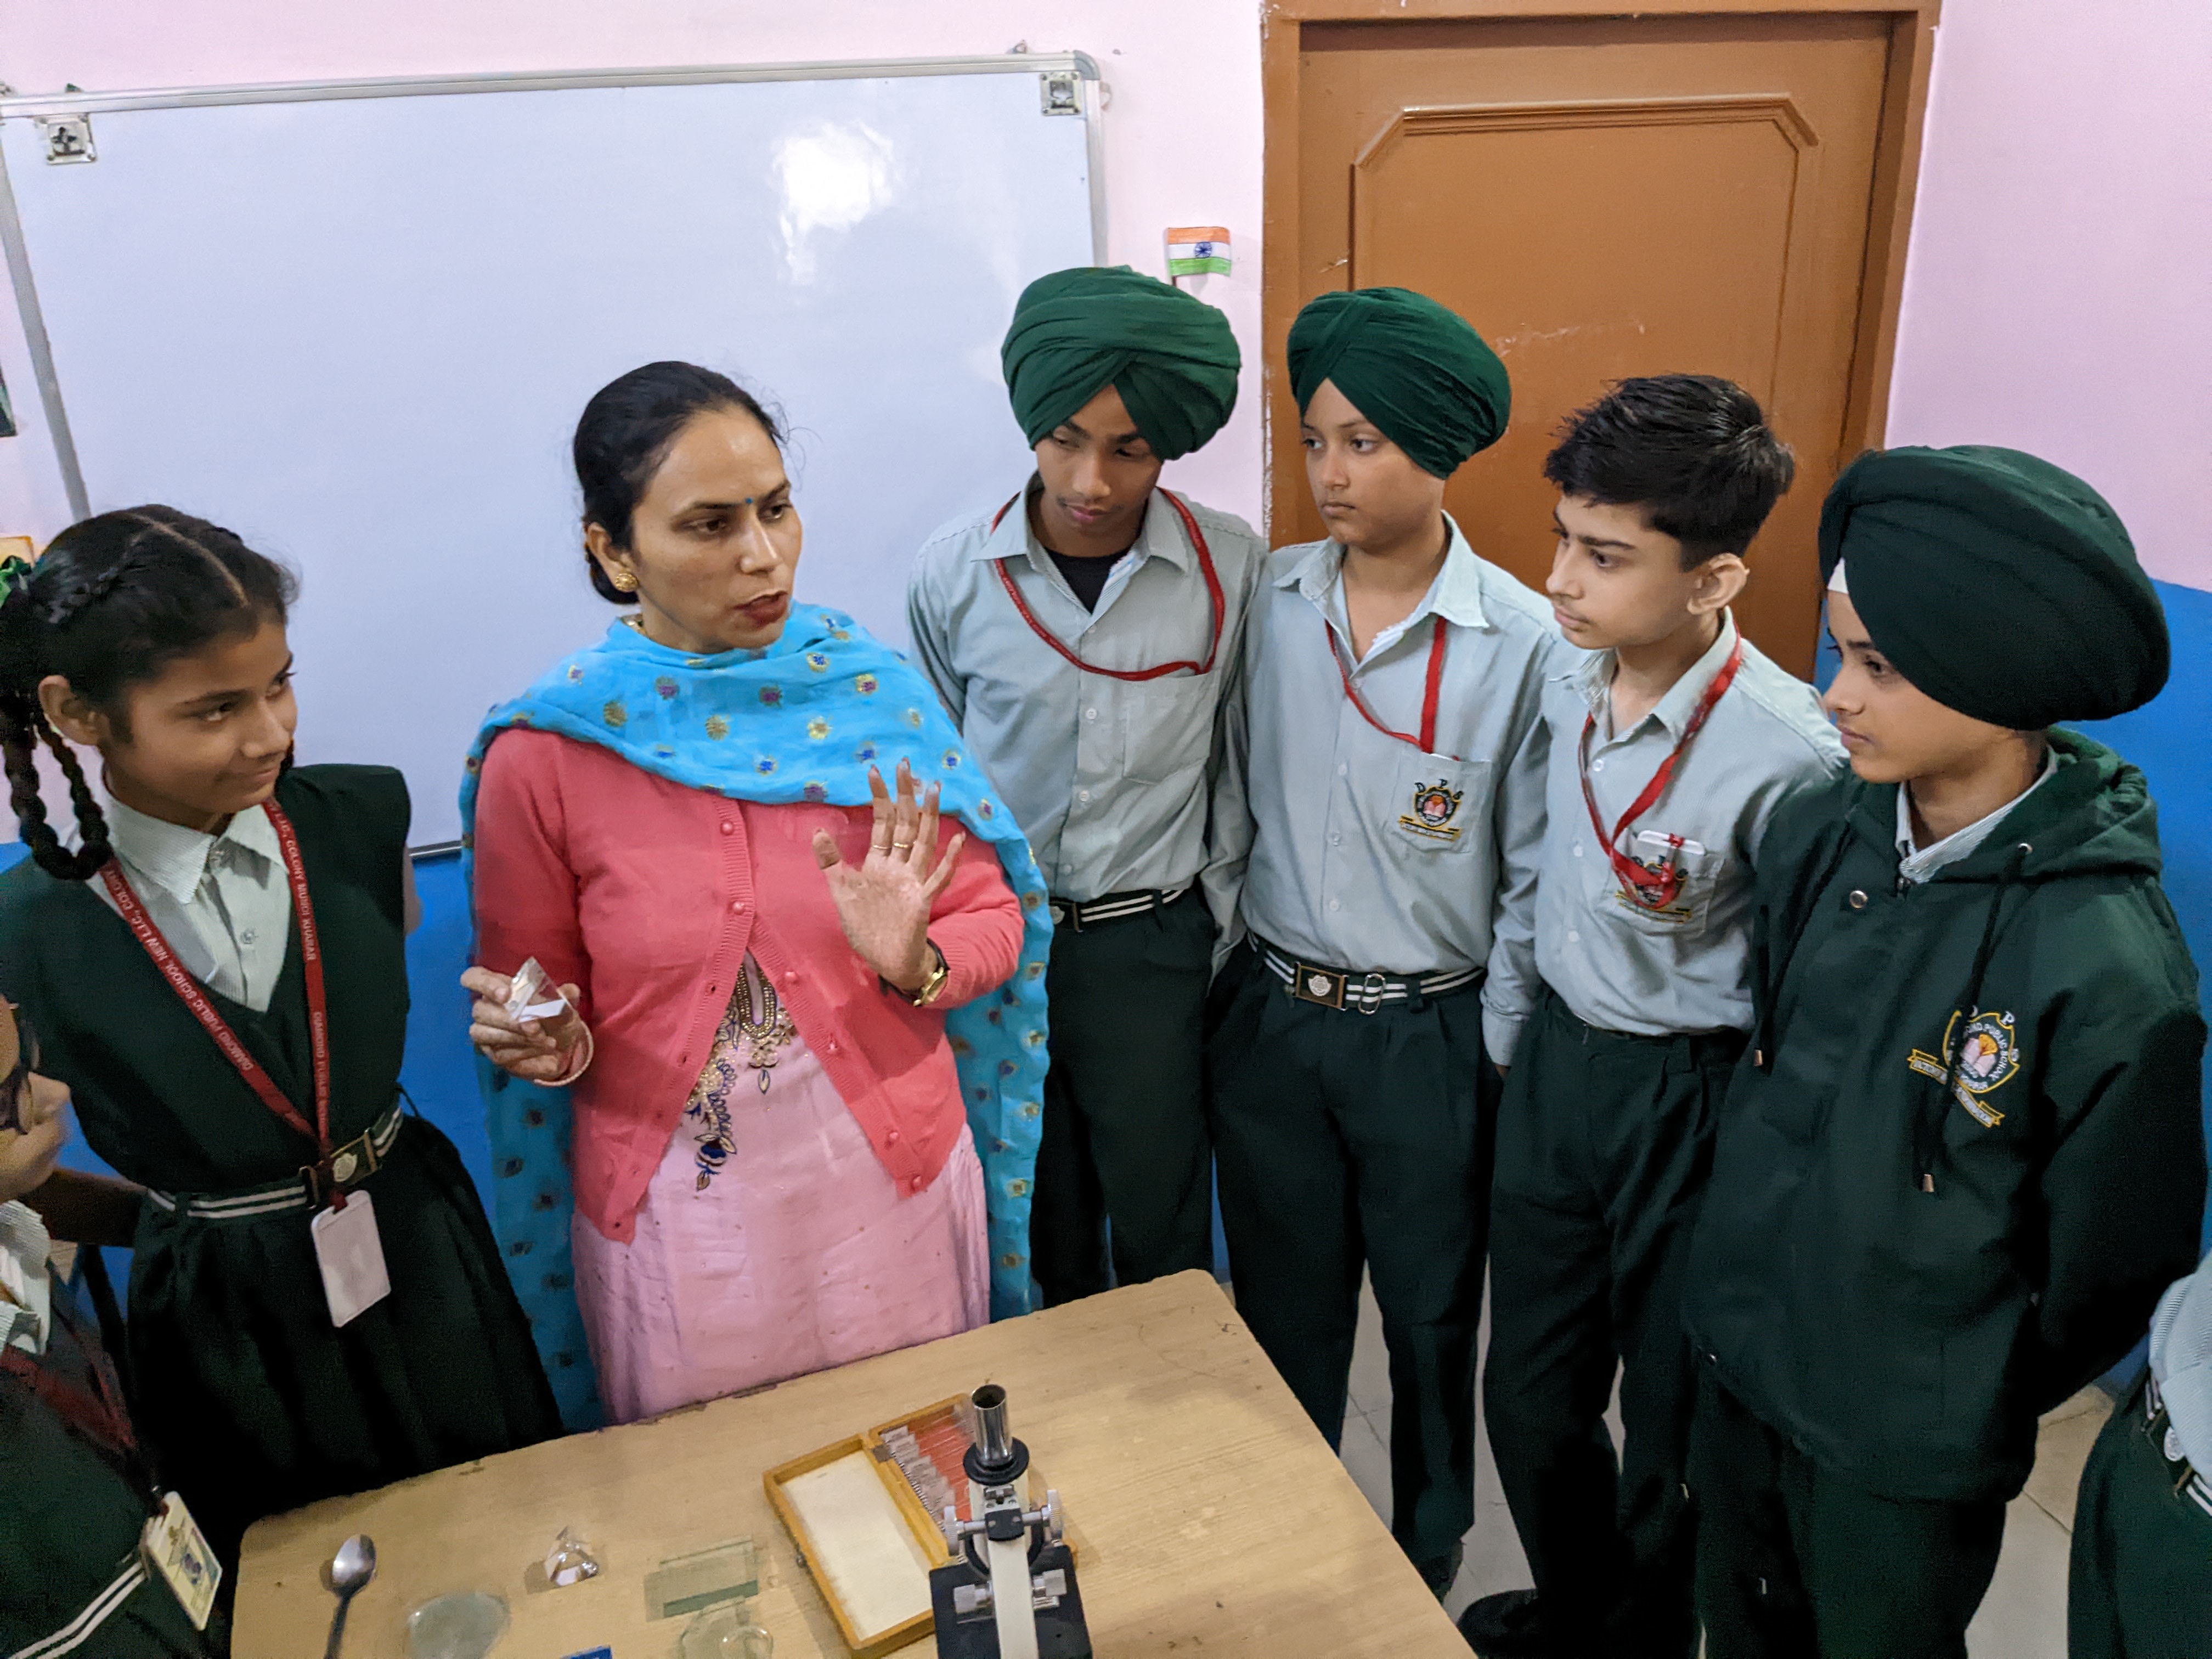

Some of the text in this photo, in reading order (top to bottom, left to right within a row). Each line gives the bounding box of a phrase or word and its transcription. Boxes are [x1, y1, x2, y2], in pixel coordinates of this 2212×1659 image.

[286, 839, 304, 881] COLONY
[145, 936, 169, 961] NEW
[166, 959, 198, 1000] SCHOOL
[193, 998, 224, 1032] PUBLIC
[219, 1031, 255, 1071] DIAMOND
